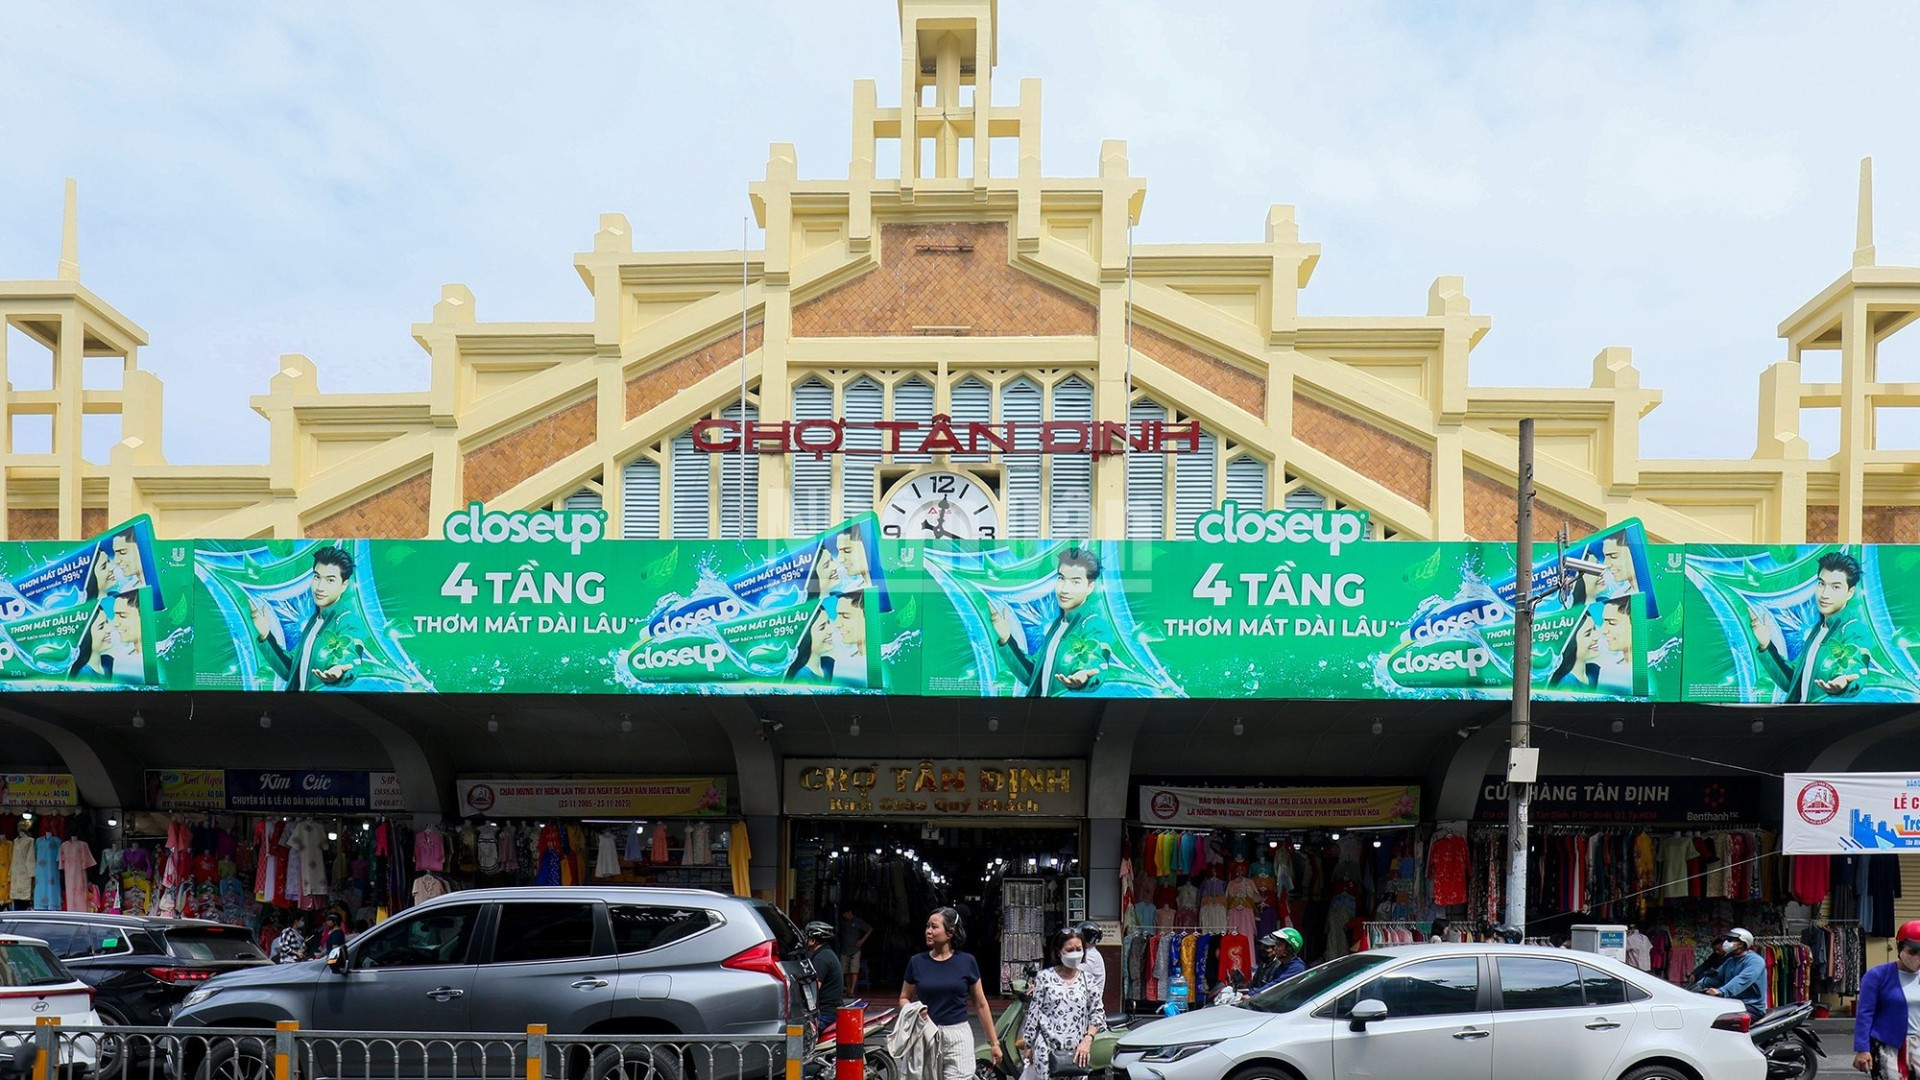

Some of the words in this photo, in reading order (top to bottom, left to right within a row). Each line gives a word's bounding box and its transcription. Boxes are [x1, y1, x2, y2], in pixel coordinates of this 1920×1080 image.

[692, 417, 845, 460] CHỢ
[874, 413, 1015, 453] TÂN
[1040, 420, 1199, 462] ĐỊNH
[929, 475, 955, 493] 12
[446, 505, 601, 555] closeup
[1199, 503, 1361, 556] closeup
[19, 576, 39, 591] THƠM
[40, 569, 56, 584] MÁT
[57, 564, 72, 578] DÀI
[72, 555, 90, 573] LÂU
[441, 562, 478, 604] 4
[485, 559, 605, 605] TẦNG
[733, 577, 756, 591] THƠM
[757, 568, 774, 582] MÁT
[775, 564, 792, 577] DÀI
[794, 553, 812, 568] LÂU
[1193, 563, 1233, 606] 4
[1239, 560, 1365, 607] TẦNG
[11, 624, 32, 634] THƠM
[34, 619, 51, 629] MÁT
[52, 616, 68, 626] DÀI
[70, 611, 89, 623] LÂU
[414, 613, 478, 633] THƠM
[485, 612, 532, 633] MÁT
[538, 612, 576, 633] DÀI
[653, 597, 740, 639] closeup
[723, 623, 747, 635] THƠM
[748, 618, 768, 631] MÁT
[769, 614, 787, 627] DÀI
[788, 611, 809, 625] LÂU
[1164, 616, 1232, 636] THƠM
[1239, 614, 1288, 636] MÁT
[1294, 614, 1335, 636] DÀI
[1414, 602, 1505, 642] closeup
[1486, 628, 1510, 640] THƠM
[1552, 616, 1575, 630] LÂU
[632, 642, 728, 672] closeup
[1392, 647, 1489, 676] closeup
[259, 773, 291, 790] Kim
[302, 773, 332, 791] Cúc
[800, 762, 880, 797] CHỢ
[890, 760, 967, 793] TÂN
[1484, 781, 1509, 801] CỬ
[1530, 782, 1577, 800] HÀNG
[1584, 781, 1619, 801] TÂN
[1624, 785, 1670, 805] ĐỊNH
[355, 797, 366, 806] EM
[1894, 792, 1907, 810] LỄ
